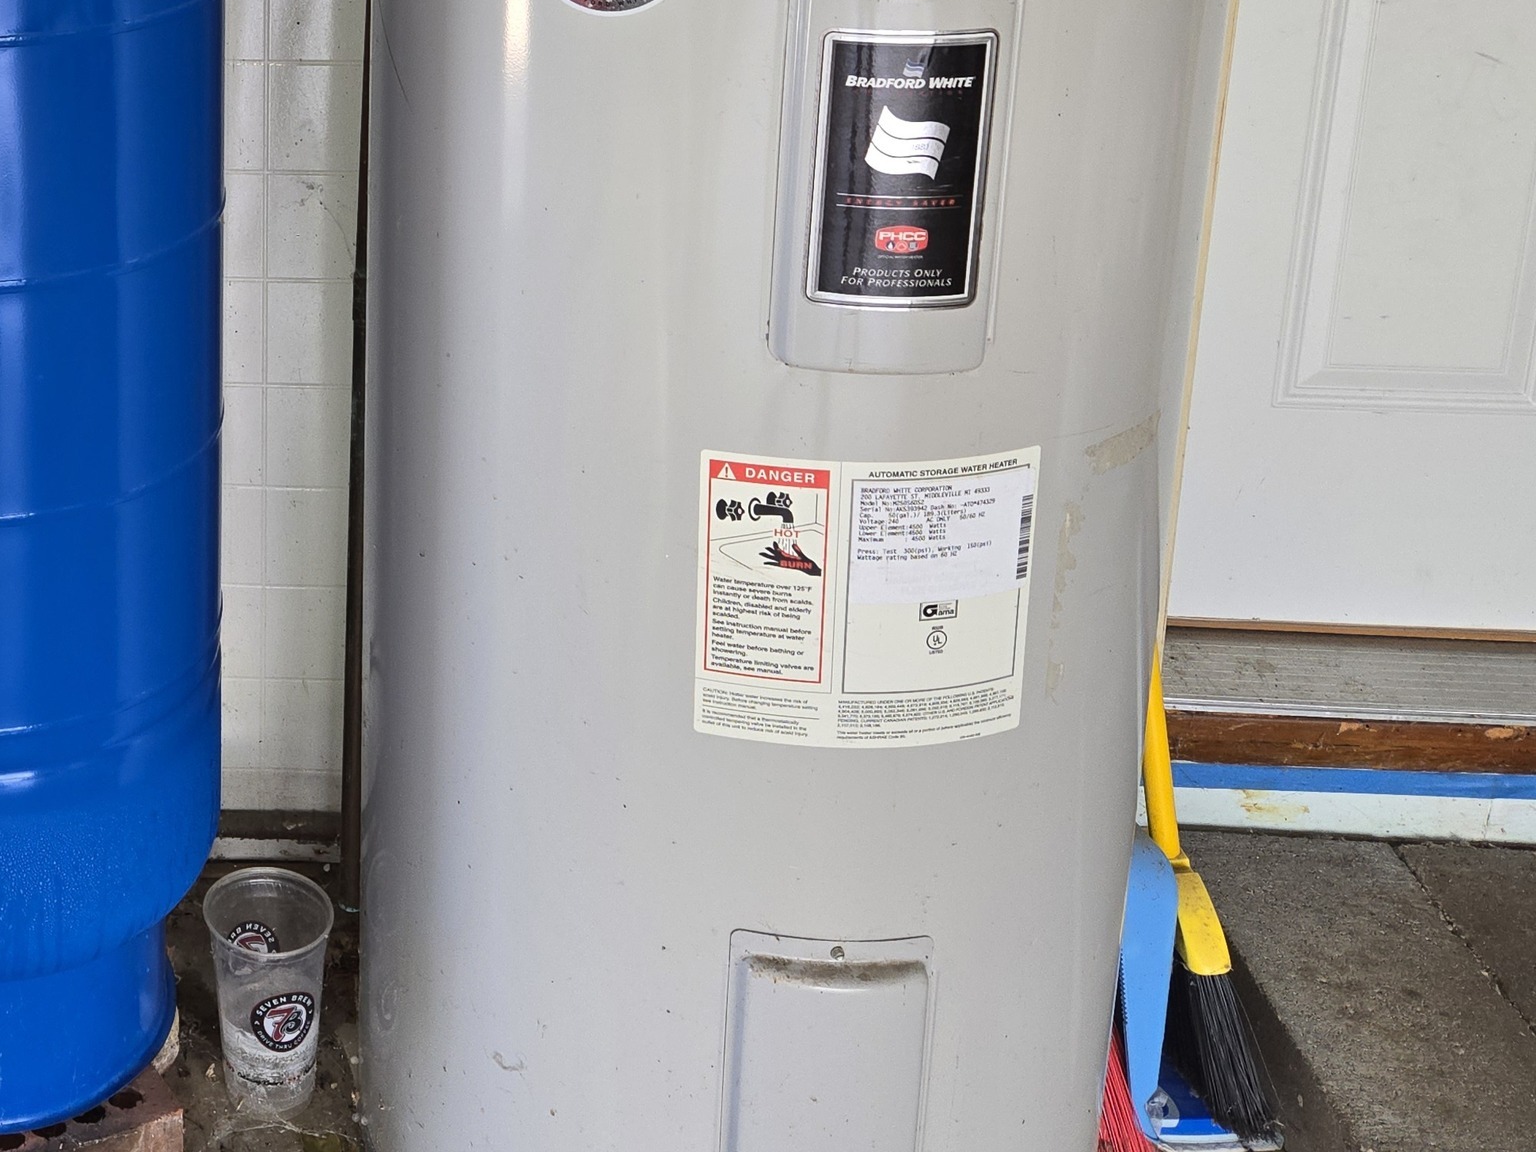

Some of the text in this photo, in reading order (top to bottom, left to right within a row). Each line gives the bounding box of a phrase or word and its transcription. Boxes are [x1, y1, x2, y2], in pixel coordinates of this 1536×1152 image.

[845, 75, 974, 88] BRADFORD WHITE
[846, 197, 955, 206] ENERGY SAVER
[879, 231, 926, 241] PHCC
[853, 267, 943, 278] PRODUCTS ONLY
[841, 276, 952, 287] FOR PROFESSIONALS
[868, 458, 1018, 478] AUTOMATIC STORAGE WATER HEATER
[745, 467, 815, 484] DANGER
[914, 485, 953, 493] CORPORATION
[774, 528, 800, 538] HOT
[779, 559, 813, 571] BURN
[713, 576, 732, 584] Water
[734, 579, 774, 588] temperature
[712, 597, 743, 607] Children,
[712, 611, 740, 619] scalded.
[732, 607, 758, 615] highest
[726, 620, 762, 630] instruction
[711, 632, 734, 640] heater.
[712, 626, 735, 634] setting
[736, 629, 776, 638] temperature
[711, 647, 747, 656] showering.
[747, 644, 768, 652] before
[770, 647, 795, 655] bathing
[711, 654, 752, 665] Temperature
[754, 660, 779, 668] limiting
[711, 661, 742, 671] available,
[256, 994, 313, 1017] SEVEN BREW
[257, 1030, 273, 1048] DRIVE
[294, 1020, 311, 1045] COFFEE
